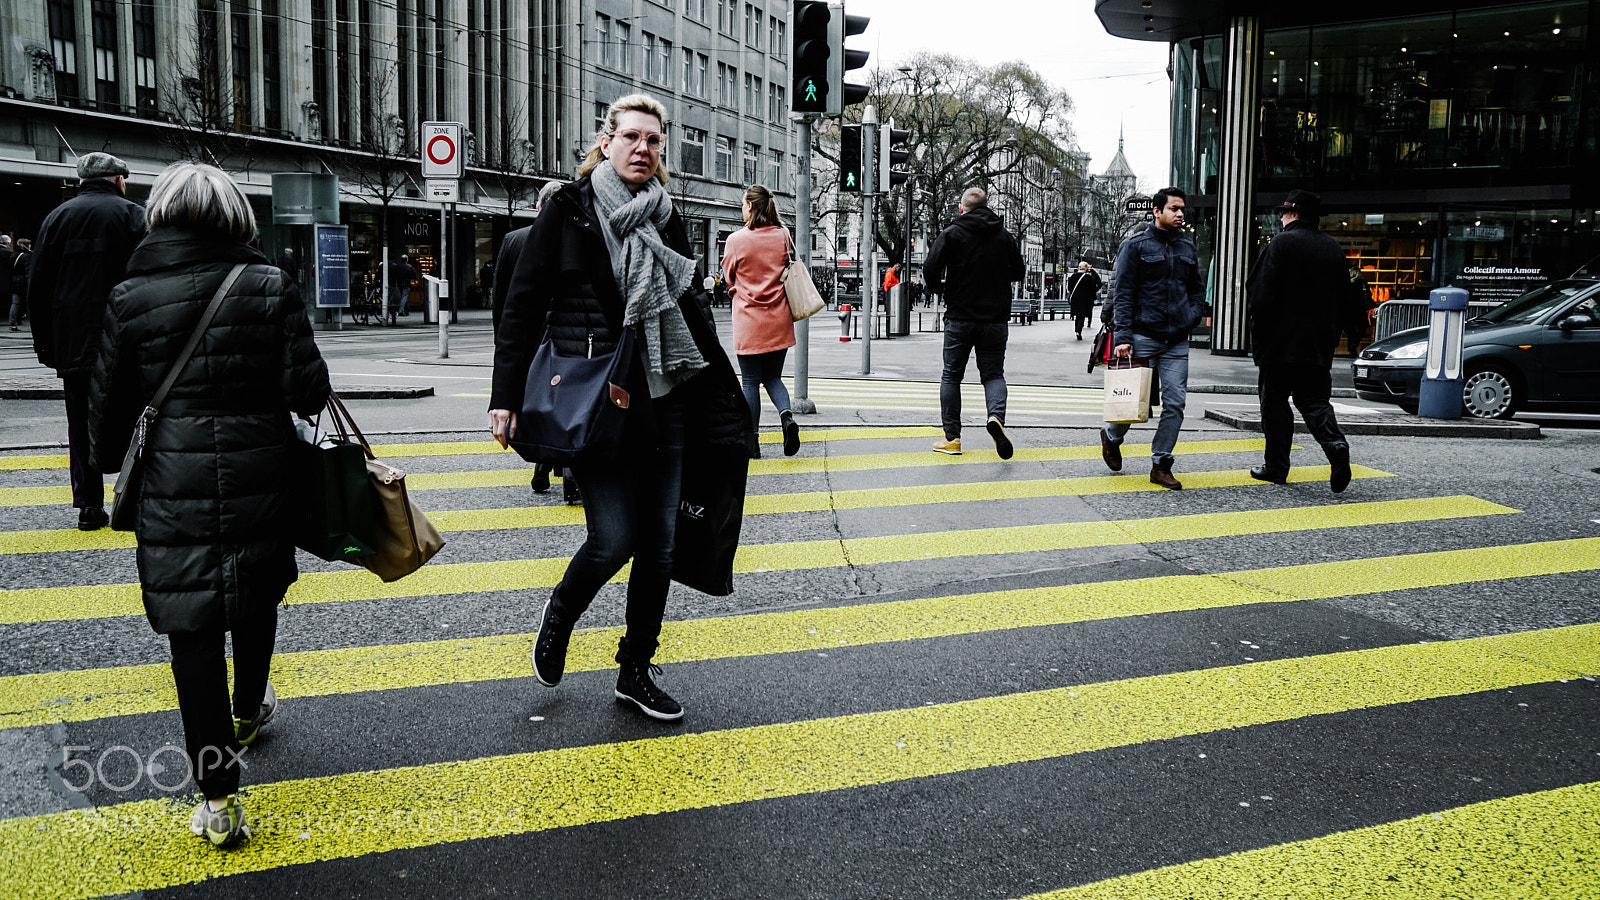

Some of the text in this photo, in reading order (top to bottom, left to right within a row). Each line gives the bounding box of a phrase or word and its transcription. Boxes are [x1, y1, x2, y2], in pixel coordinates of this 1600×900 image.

[404, 223, 429, 236] NOR
[1463, 266, 1496, 274] Collectif
[1112, 387, 1132, 397] Salt.
